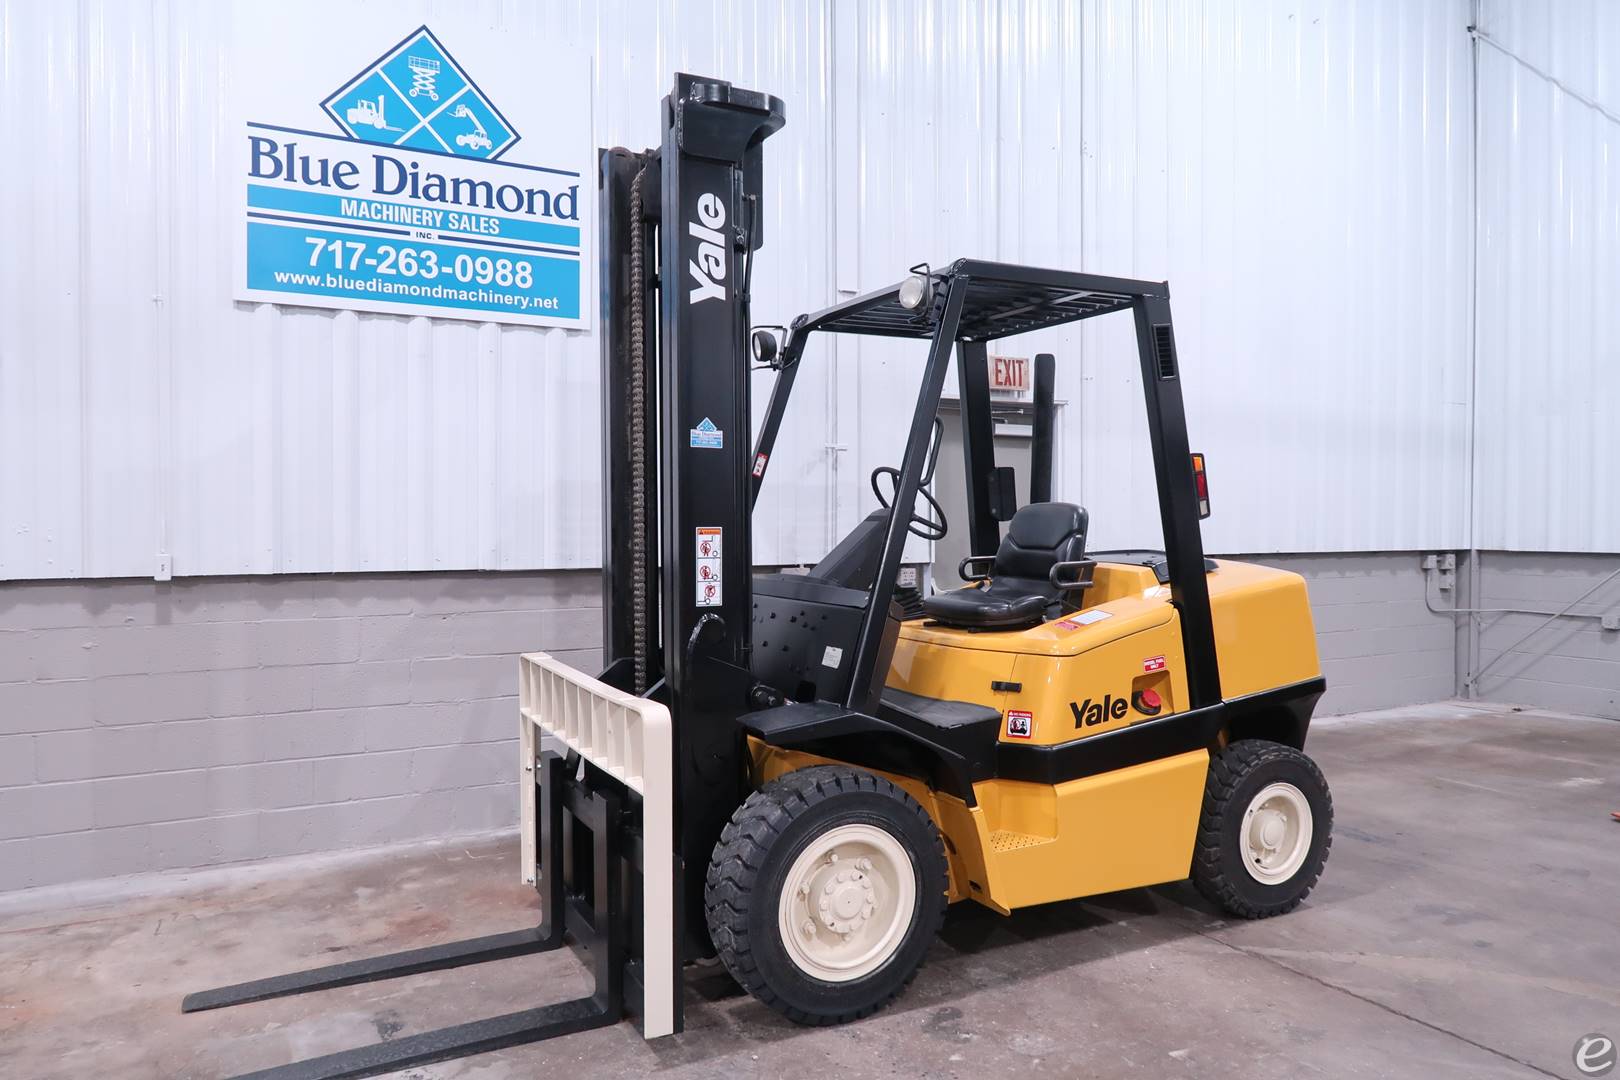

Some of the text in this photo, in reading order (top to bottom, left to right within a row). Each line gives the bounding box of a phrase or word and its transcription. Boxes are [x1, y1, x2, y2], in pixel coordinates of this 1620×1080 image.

[248, 135, 579, 221] Blue Diamond
[340, 198, 500, 235] MACHINERY SALES
[416, 231, 435, 240] INC.
[304, 236, 534, 289] 717-263-0988
[689, 192, 726, 304] Yale
[274, 271, 559, 310] www.bluediamondmachinery.net
[995, 358, 1024, 387] EXIT
[1070, 694, 1128, 729] Yale
